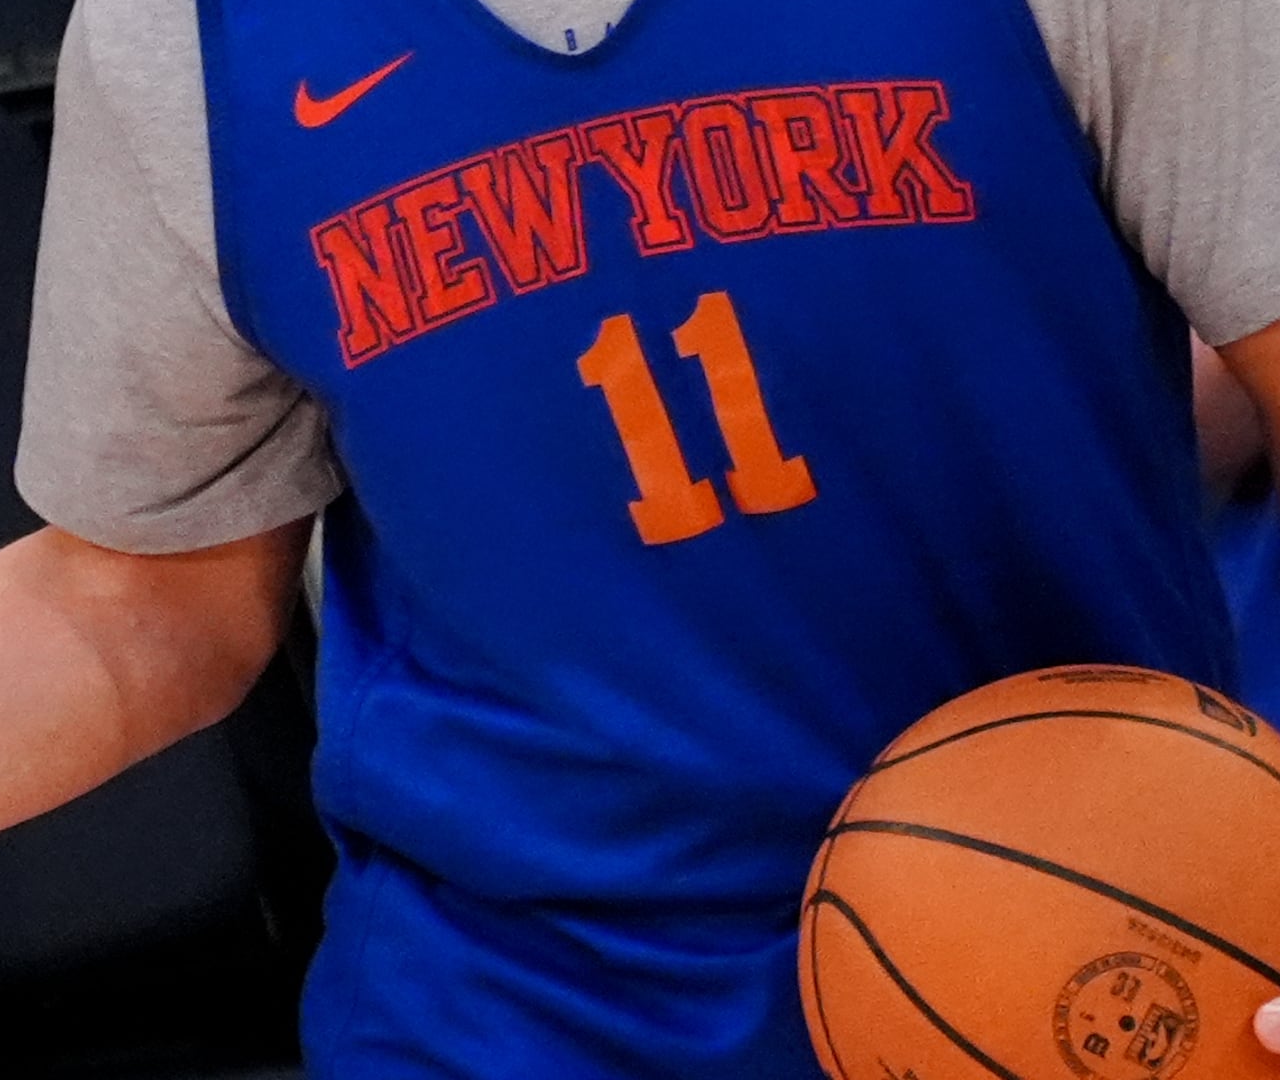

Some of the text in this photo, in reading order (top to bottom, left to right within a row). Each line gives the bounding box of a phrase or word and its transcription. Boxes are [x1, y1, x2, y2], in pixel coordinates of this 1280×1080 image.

[309, 81, 974, 369] NEW YORK
[576, 290, 818, 546] 11
